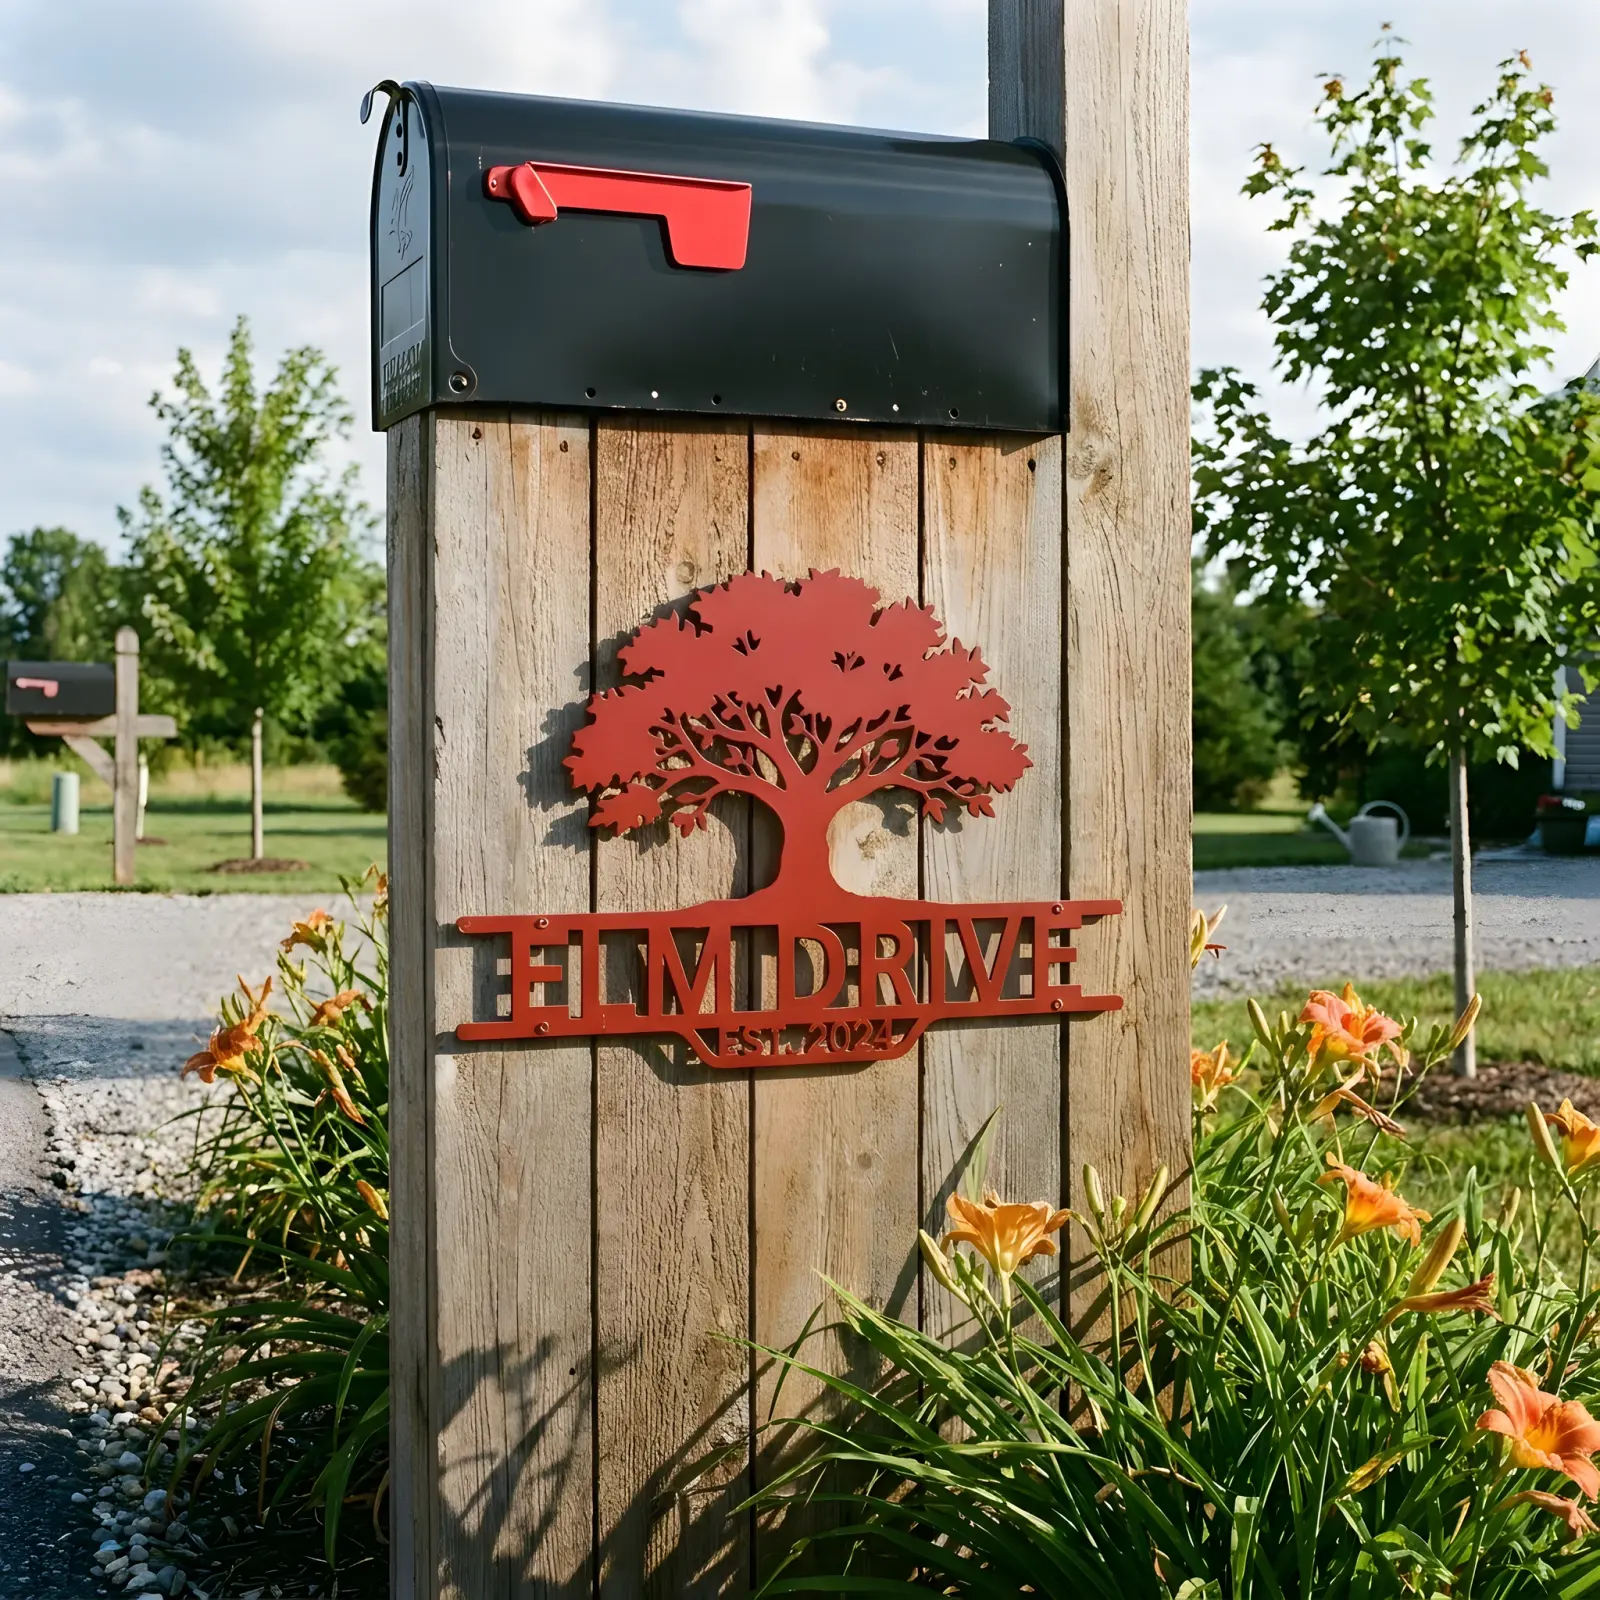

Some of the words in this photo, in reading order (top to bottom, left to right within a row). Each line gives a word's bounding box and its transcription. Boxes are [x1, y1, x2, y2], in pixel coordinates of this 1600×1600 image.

[512, 923, 732, 1018] ELM
[778, 916, 1082, 1009] DRIVE
[808, 1019, 894, 1052] 2024
